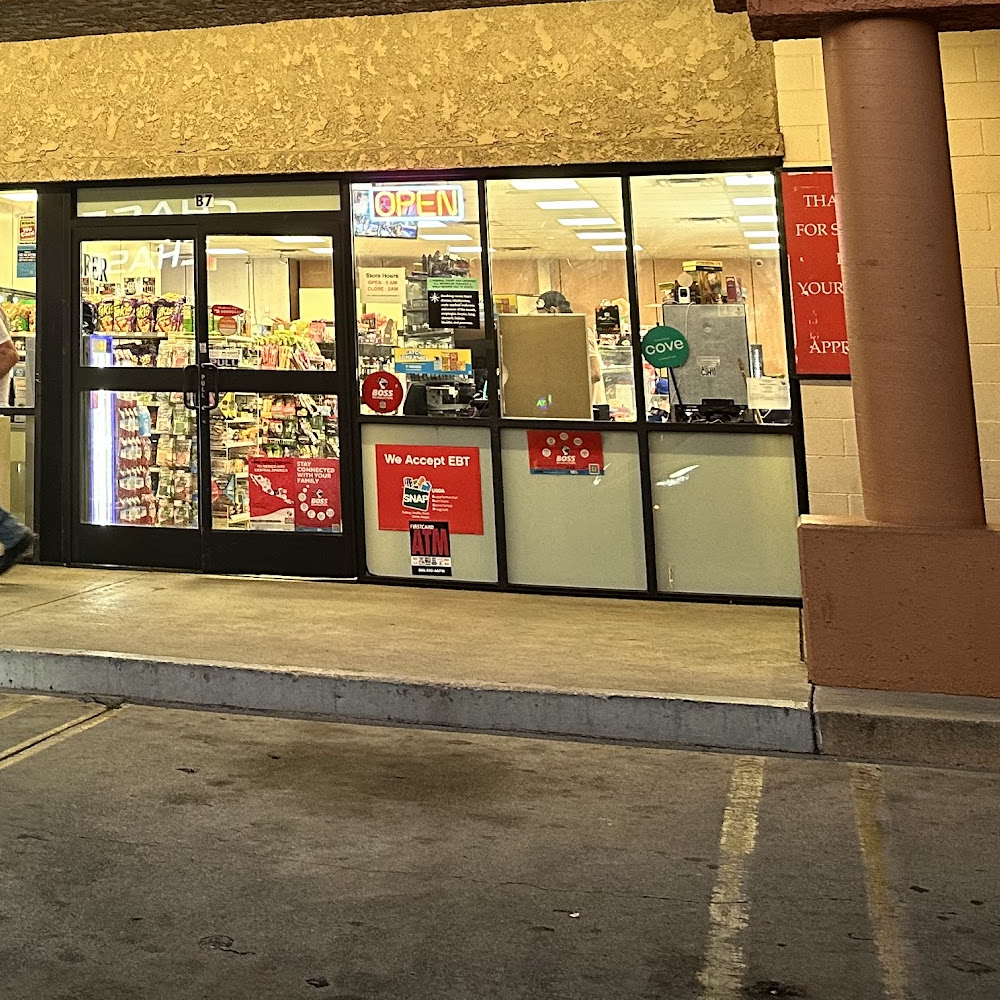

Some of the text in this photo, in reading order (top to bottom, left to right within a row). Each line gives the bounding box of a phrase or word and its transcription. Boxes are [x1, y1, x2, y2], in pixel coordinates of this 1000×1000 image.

[195, 194, 213, 207] B7
[374, 189, 459, 218] OPEN
[795, 223, 827, 237] FOR
[797, 281, 844, 296] YOUR
[645, 341, 685, 356] cove
[372, 389, 394, 397] BOSS
[384, 453, 471, 469] We Accept EBT
[403, 494, 429, 504] SNAP
[411, 529, 450, 556] ATM
